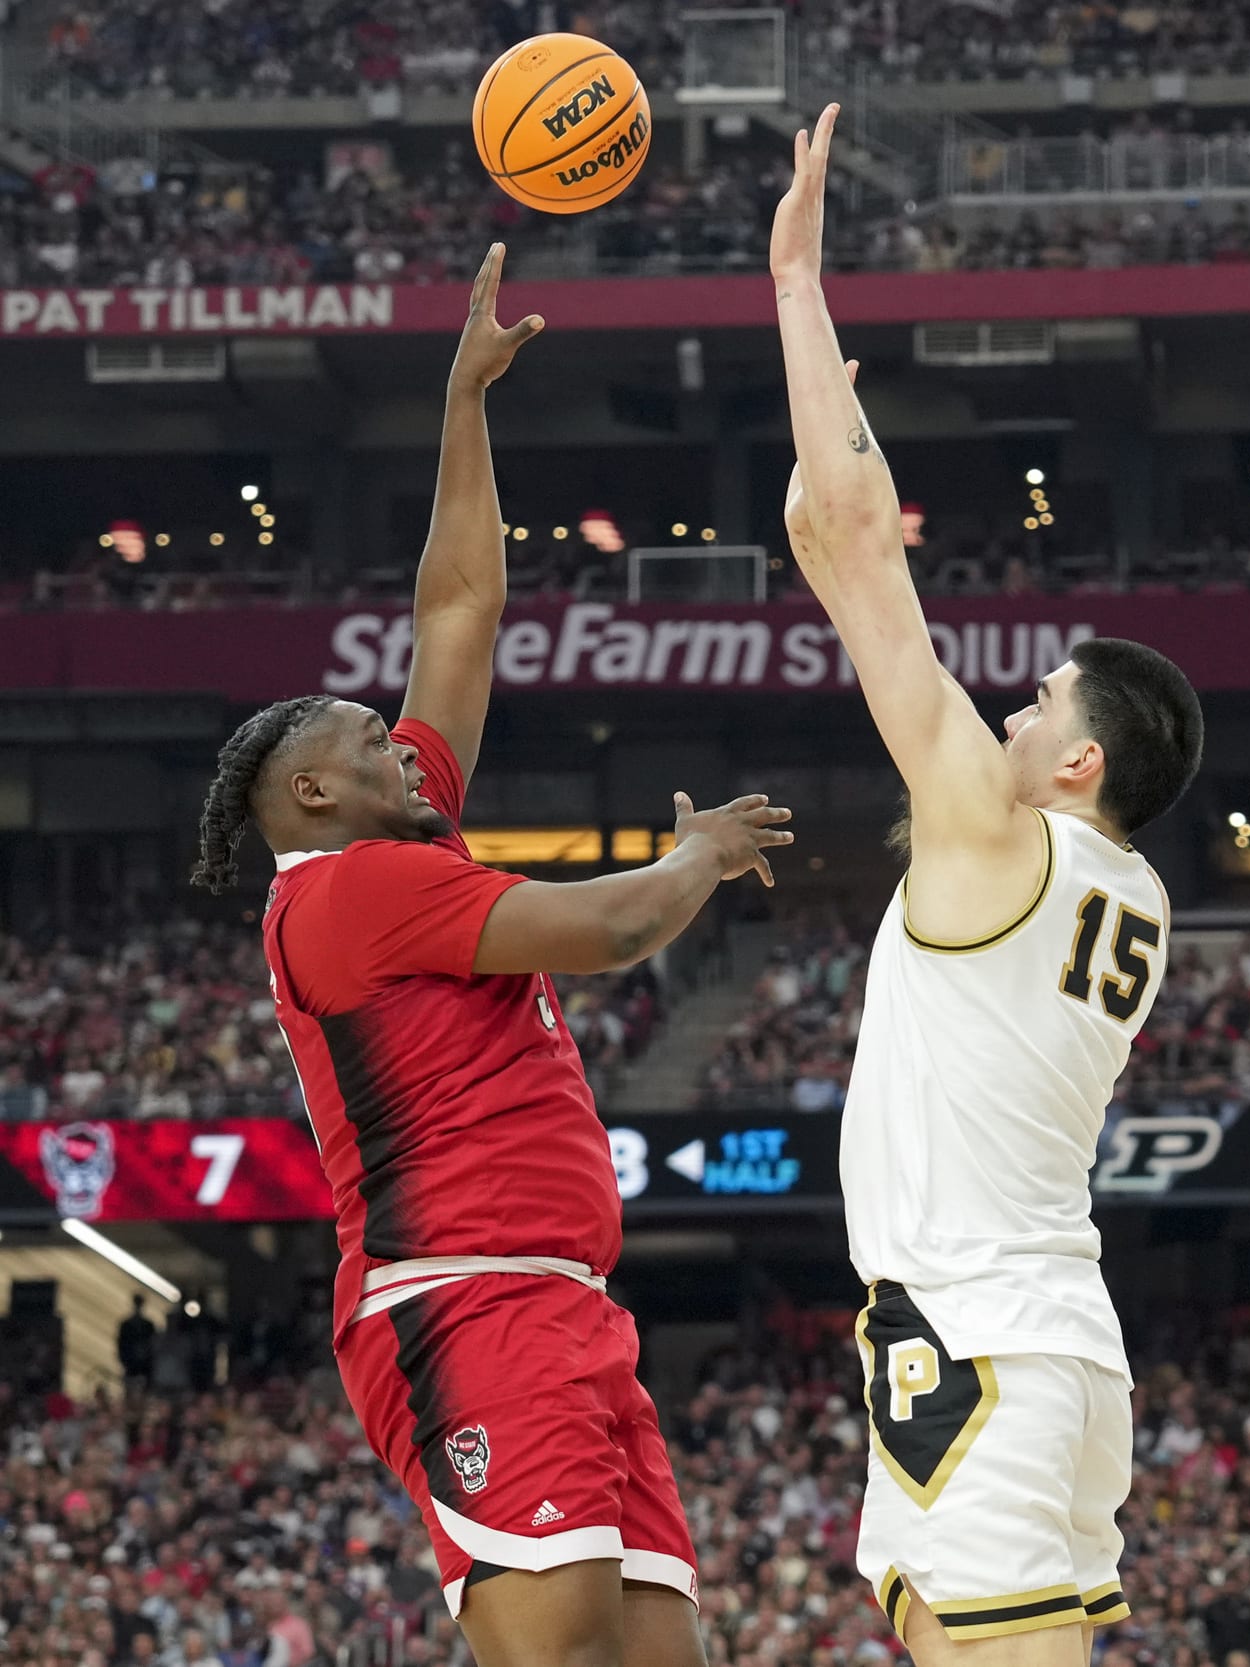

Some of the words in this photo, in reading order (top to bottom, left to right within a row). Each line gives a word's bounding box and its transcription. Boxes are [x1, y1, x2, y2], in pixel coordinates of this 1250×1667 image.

[542, 74, 616, 140] NCAA
[556, 112, 649, 186] Wilson
[3, 289, 115, 333] PAT
[130, 286, 393, 331] TILLMAN
[322, 602, 772, 692] SteFarm
[780, 622, 1096, 688] STDIUM
[1058, 887, 1161, 1024] 15
[191, 1134, 245, 1205] 7
[703, 1159, 801, 1194] HALF
[720, 1129, 789, 1161] 1ST
[888, 1337, 940, 1422] P
[531, 1511, 566, 1527] adidas
